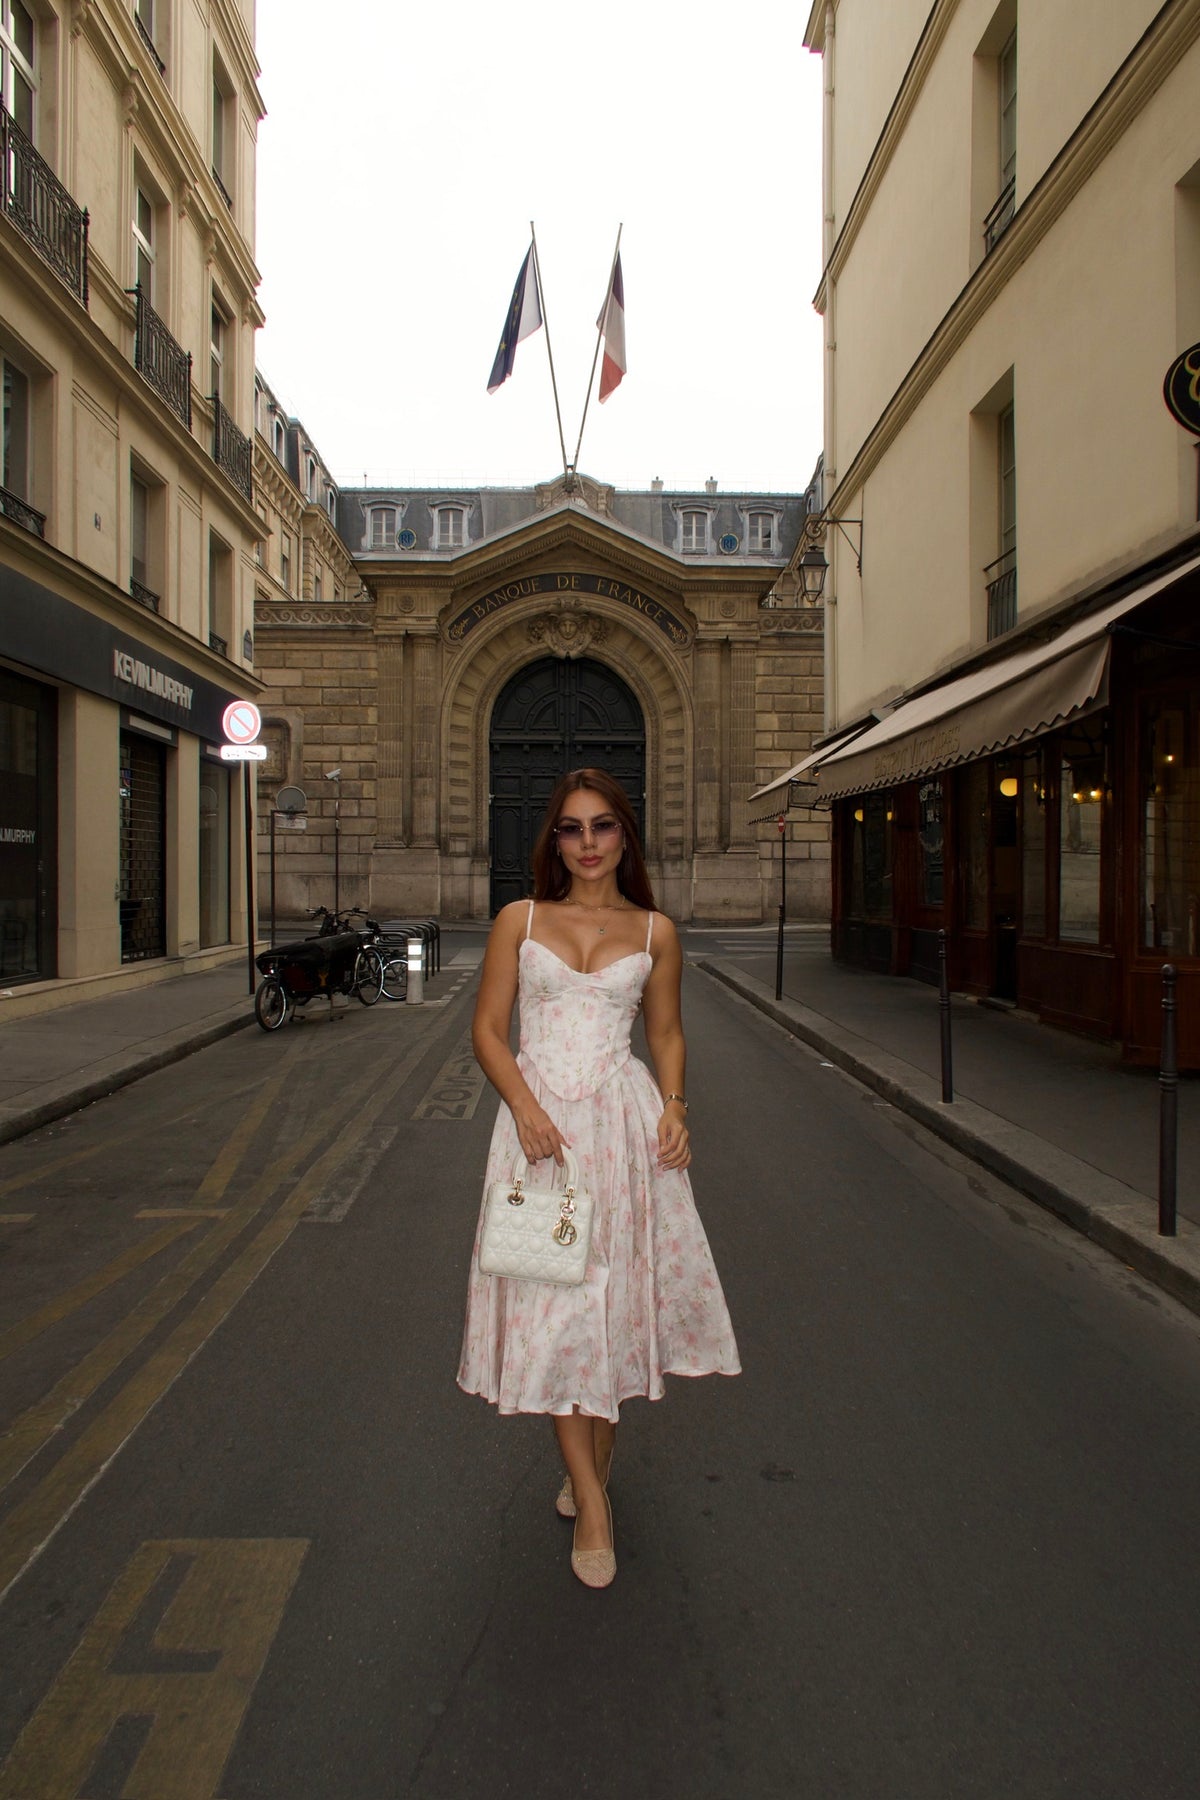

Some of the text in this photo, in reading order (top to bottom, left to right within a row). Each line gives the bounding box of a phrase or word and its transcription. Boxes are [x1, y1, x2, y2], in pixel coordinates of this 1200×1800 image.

[471, 575, 667, 625] BANQUE DE FRANCE
[114, 649, 194, 710] KEVIN.MURPHY
